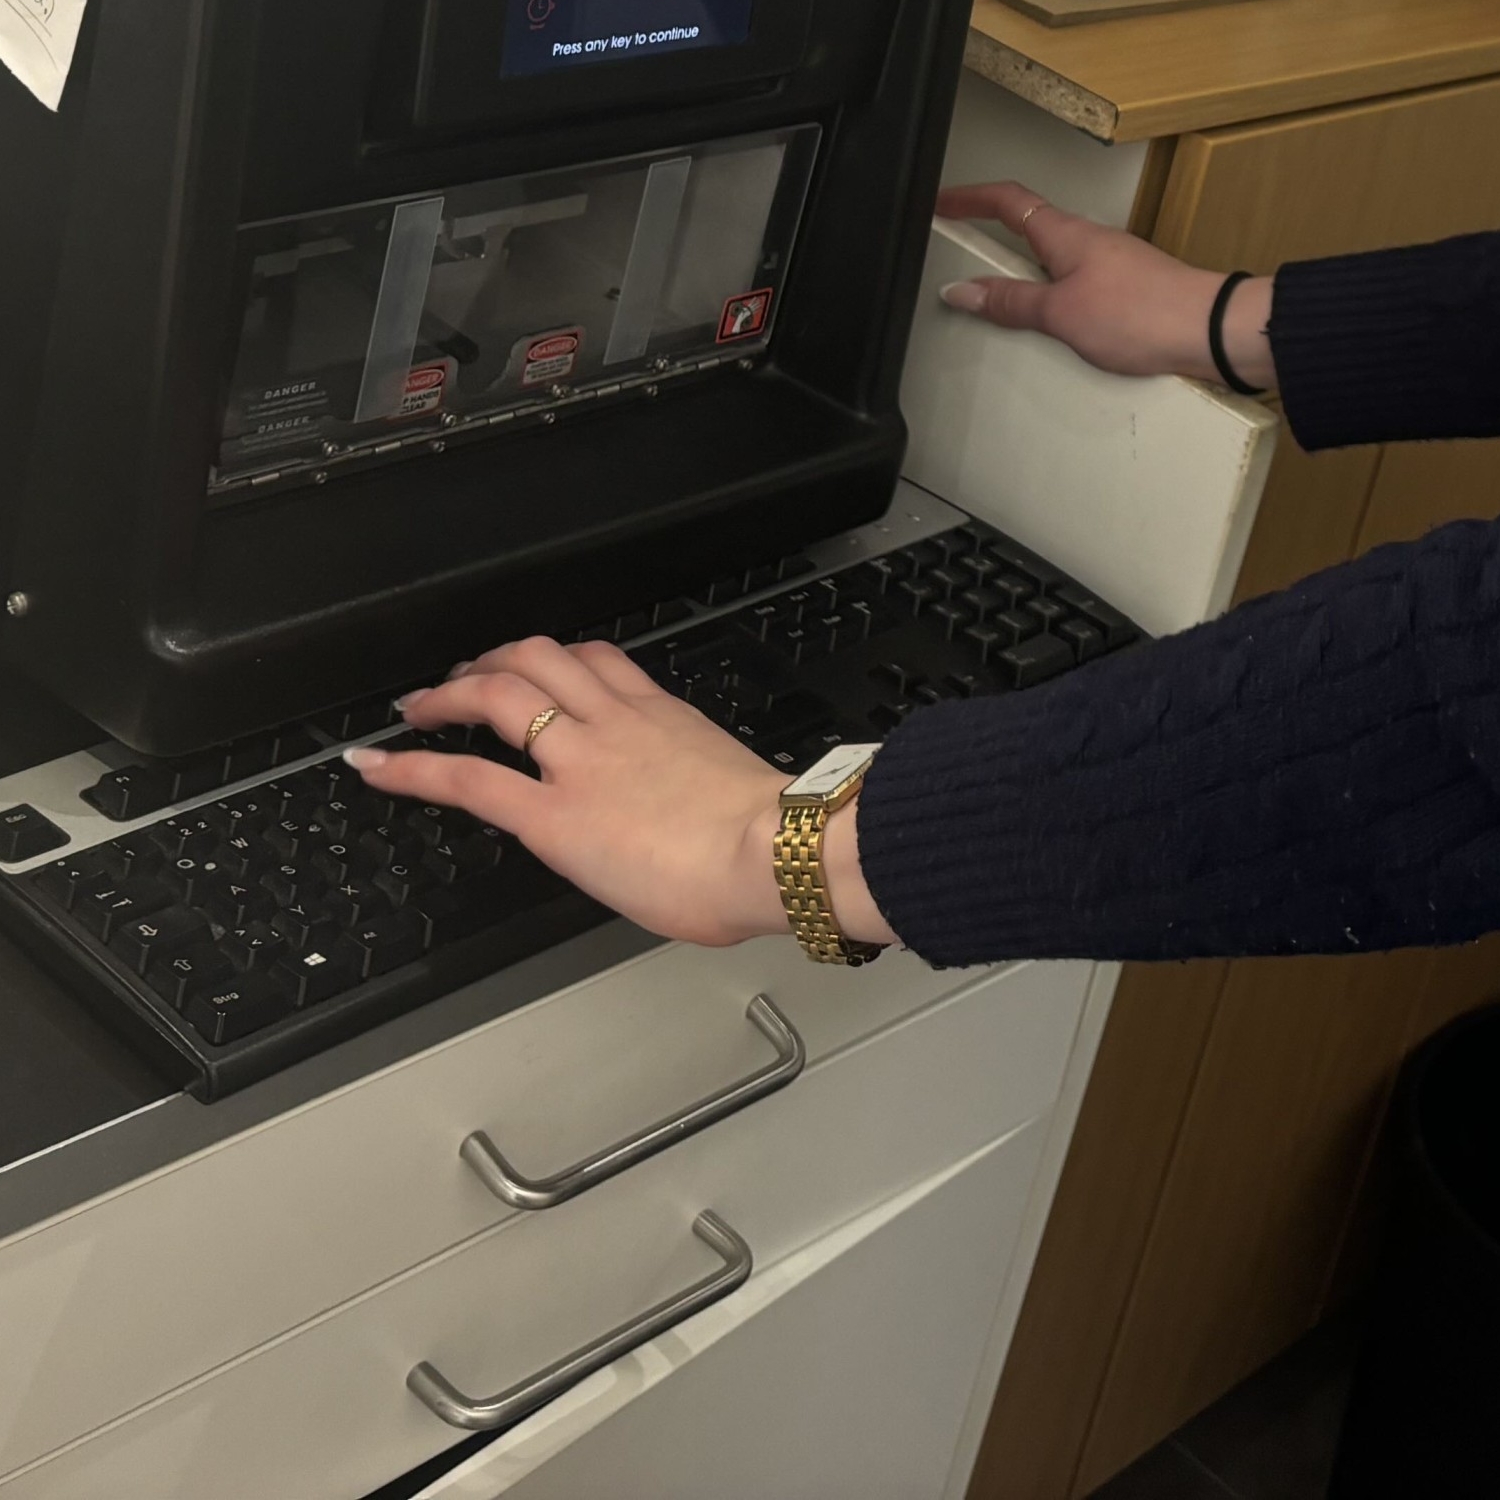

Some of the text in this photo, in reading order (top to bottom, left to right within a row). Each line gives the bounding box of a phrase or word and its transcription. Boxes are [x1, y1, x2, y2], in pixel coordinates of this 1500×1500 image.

[552, 24, 700, 57] Press any key to continue
[264, 381, 317, 400] DANGER
[258, 415, 311, 434] DANGER
[329, 800, 348, 812] R
[5, 813, 27, 825] Esc
[281, 819, 299, 832] E
[377, 826, 392, 837] F
[230, 836, 250, 849] W
[328, 844, 347, 856] D
[437, 845, 454, 857] V
[176, 858, 197, 871] Q
[280, 864, 298, 876] S
[391, 865, 409, 876] C
[229, 883, 248, 896] A
[340, 884, 360, 897] X
[288, 904, 306, 917] Y
[212, 990, 240, 1005] Strg
